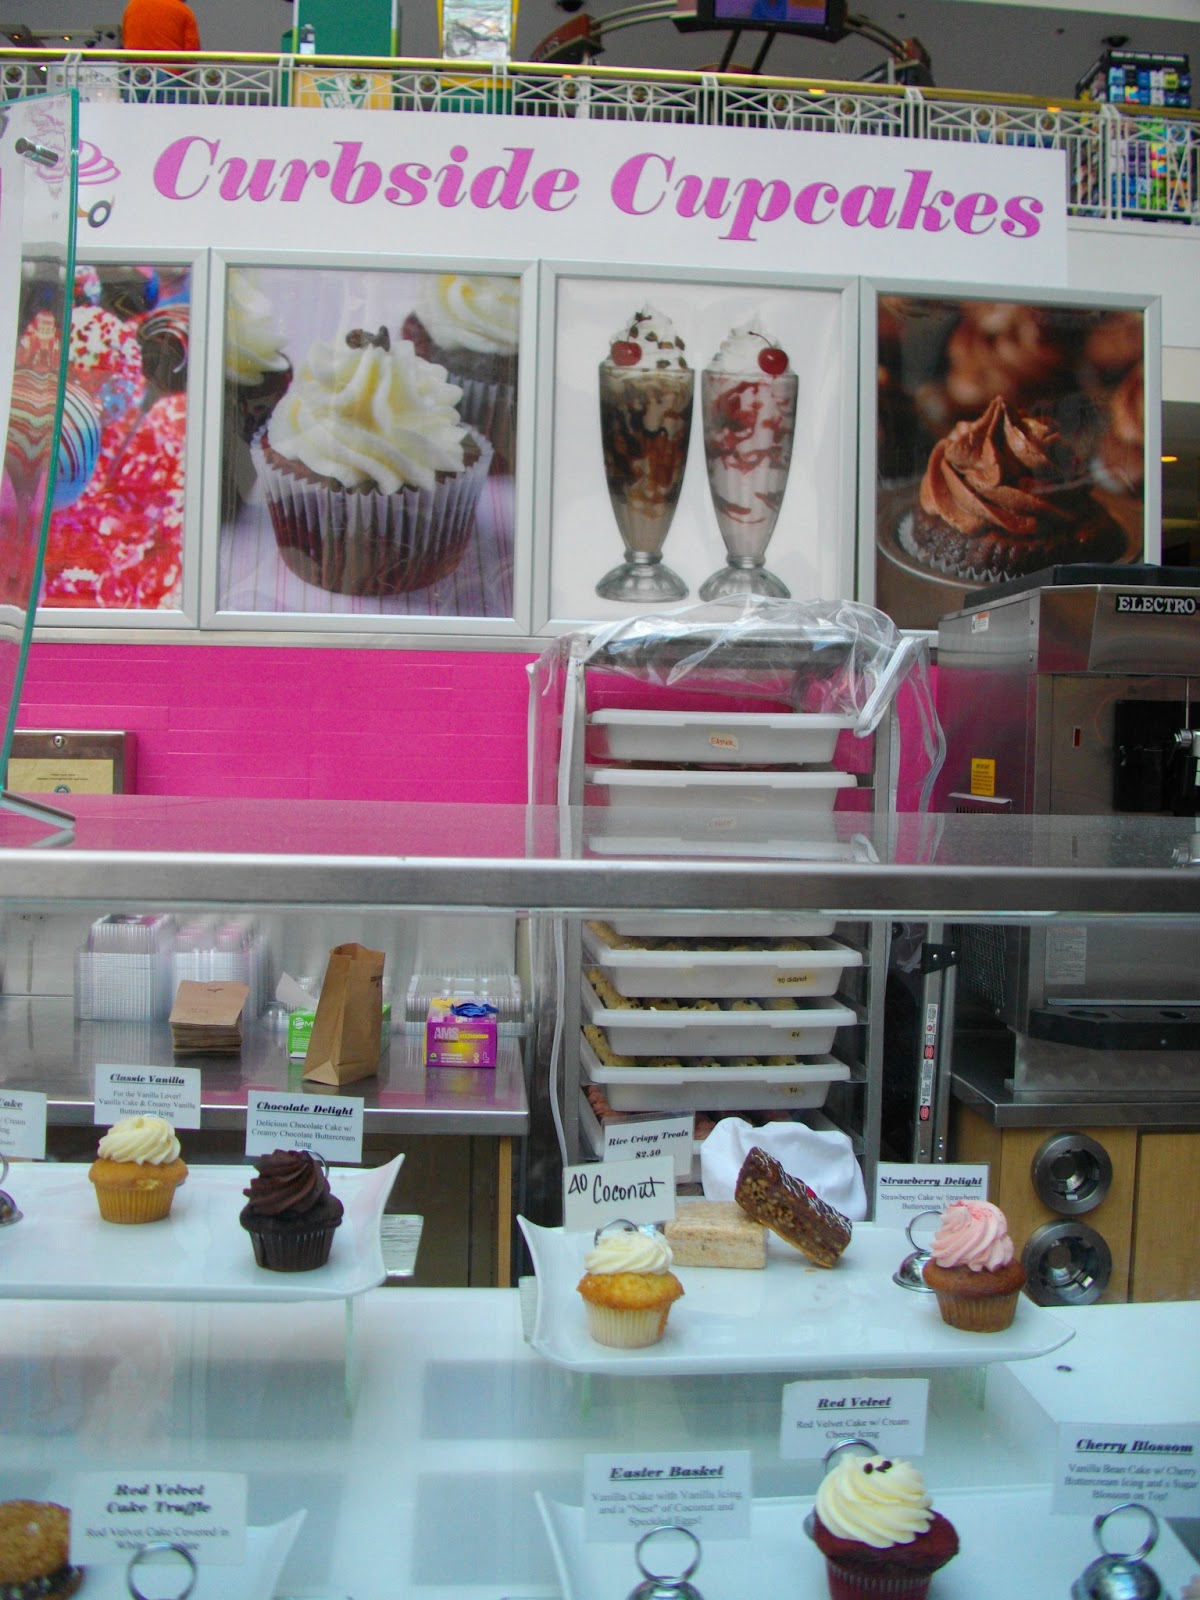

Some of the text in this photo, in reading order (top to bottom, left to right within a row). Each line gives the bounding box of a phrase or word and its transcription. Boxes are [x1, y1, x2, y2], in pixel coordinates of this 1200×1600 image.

[153, 135, 1044, 241] Curbside Cupcakes
[1118, 596, 1196, 614] ELECTRO
[110, 1074, 185, 1084] Classic Vanilla
[160, 1092, 181, 1100] Lover!
[148, 1101, 171, 1109] Creamy
[257, 1101, 353, 1116] Chocolate Delight
[159, 1110, 174, 1118] Icing
[290, 1122, 323, 1130] Chocolate
[252, 1130, 356, 1141] Creamy Chocolate Buttercream
[608, 1130, 688, 1146] Rice Crispy Treats
[295, 1140, 312, 1149] Icing
[636, 1149, 661, 1159] $2.50
[880, 1177, 982, 1186] Strawberry Delight
[593, 1175, 665, 1204] Coconut
[818, 1397, 892, 1408] Red Velvet
[816, 1420, 843, 1428] Velvet
[845, 1419, 866, 1427] Cake
[882, 1418, 909, 1426] Cream
[826, 1430, 880, 1439] Cheese Icing
[1076, 1439, 1193, 1454] Cherry Blossom
[610, 1465, 724, 1478] Easter Basket
[1068, 1464, 1100, 1473] Vanilla
[1103, 1464, 1125, 1473] Bean
[1128, 1465, 1152, 1474] Cake
[1166, 1466, 1196, 1477] Cherry
[1064, 1476, 1119, 1486] Buttercream
[1121, 1478, 1144, 1489] Icing
[1146, 1479, 1163, 1487] and
[1172, 1479, 1198, 1490] Sugar
[116, 1484, 205, 1496] Red Velvet
[592, 1490, 742, 1501] Vanilla Cake with Vanilla Icing
[1092, 1490, 1131, 1499] Blossom
[106, 1501, 212, 1516] Cake Truffle
[599, 1506, 615, 1514] and
[661, 1504, 673, 1512] of
[674, 1503, 714, 1512] Coconut
[717, 1502, 734, 1511] and
